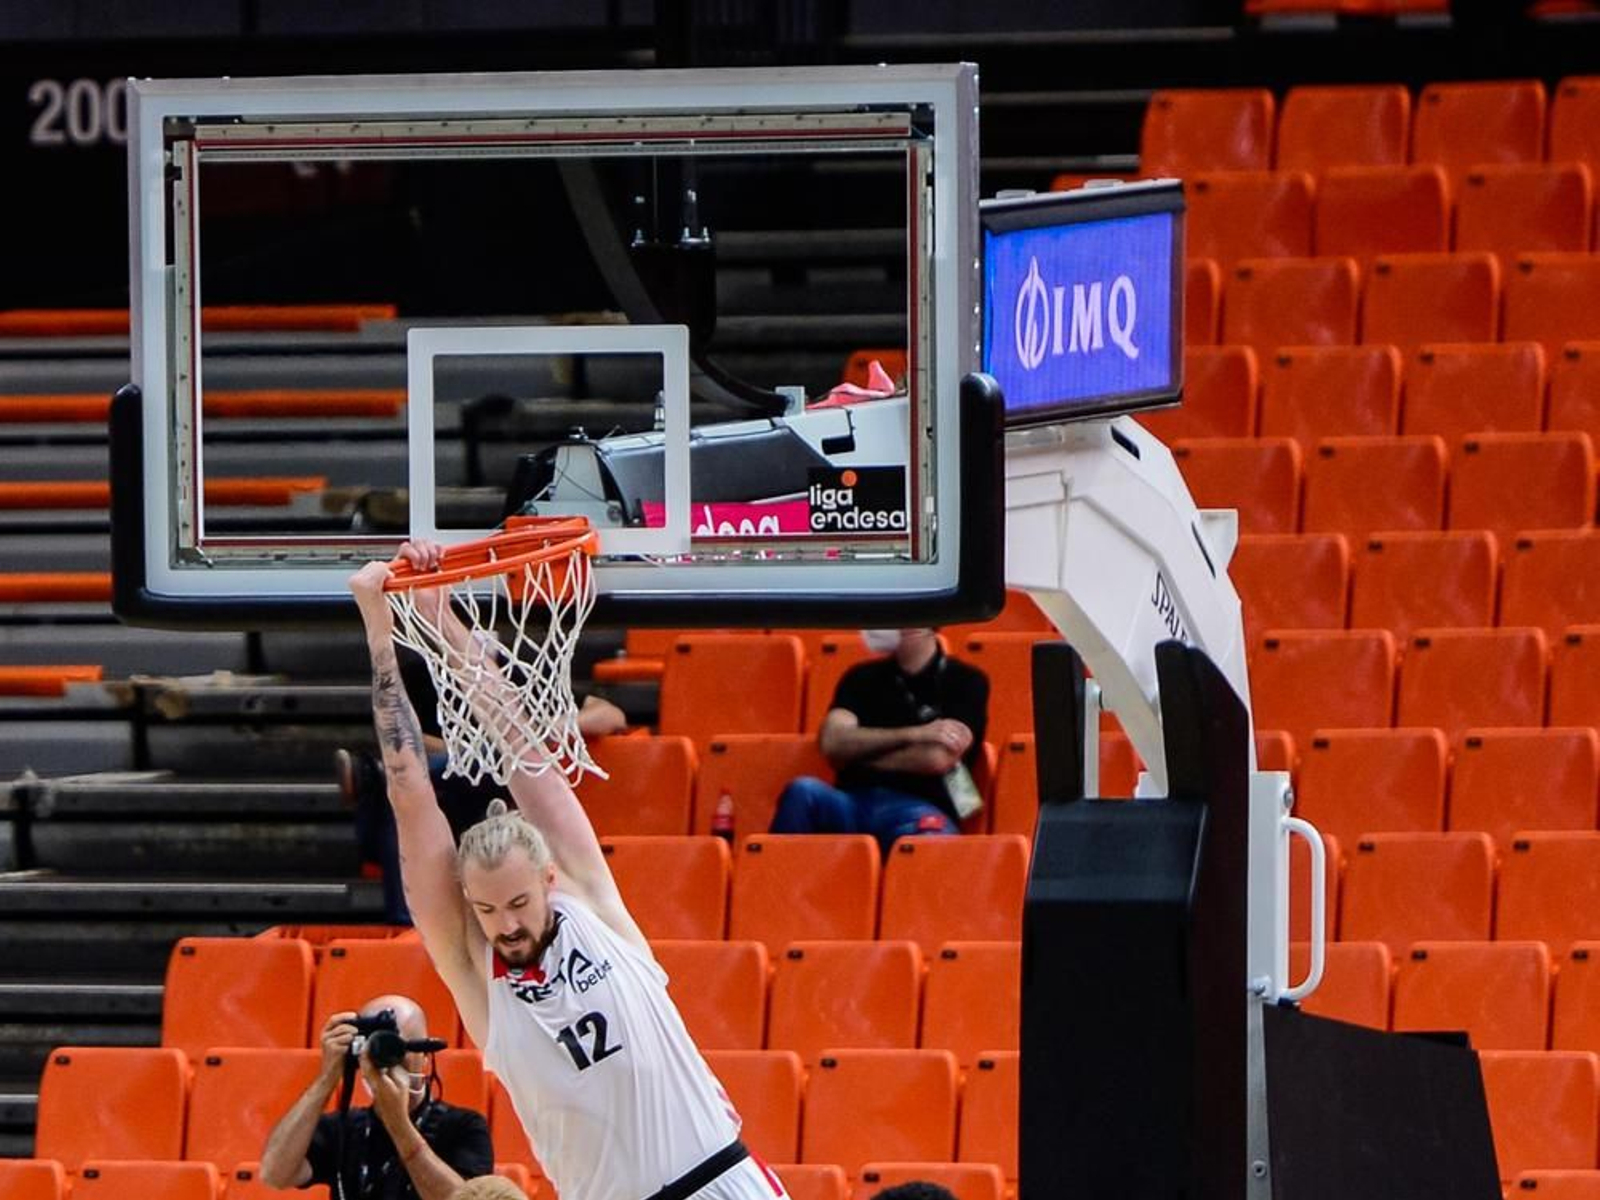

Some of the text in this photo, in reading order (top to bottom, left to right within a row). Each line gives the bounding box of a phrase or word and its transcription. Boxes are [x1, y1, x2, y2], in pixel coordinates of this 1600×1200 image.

[1052, 275, 1139, 360] IMQ
[810, 484, 853, 510] liga
[810, 507, 906, 530] endesa
[557, 1011, 623, 1071] 12
